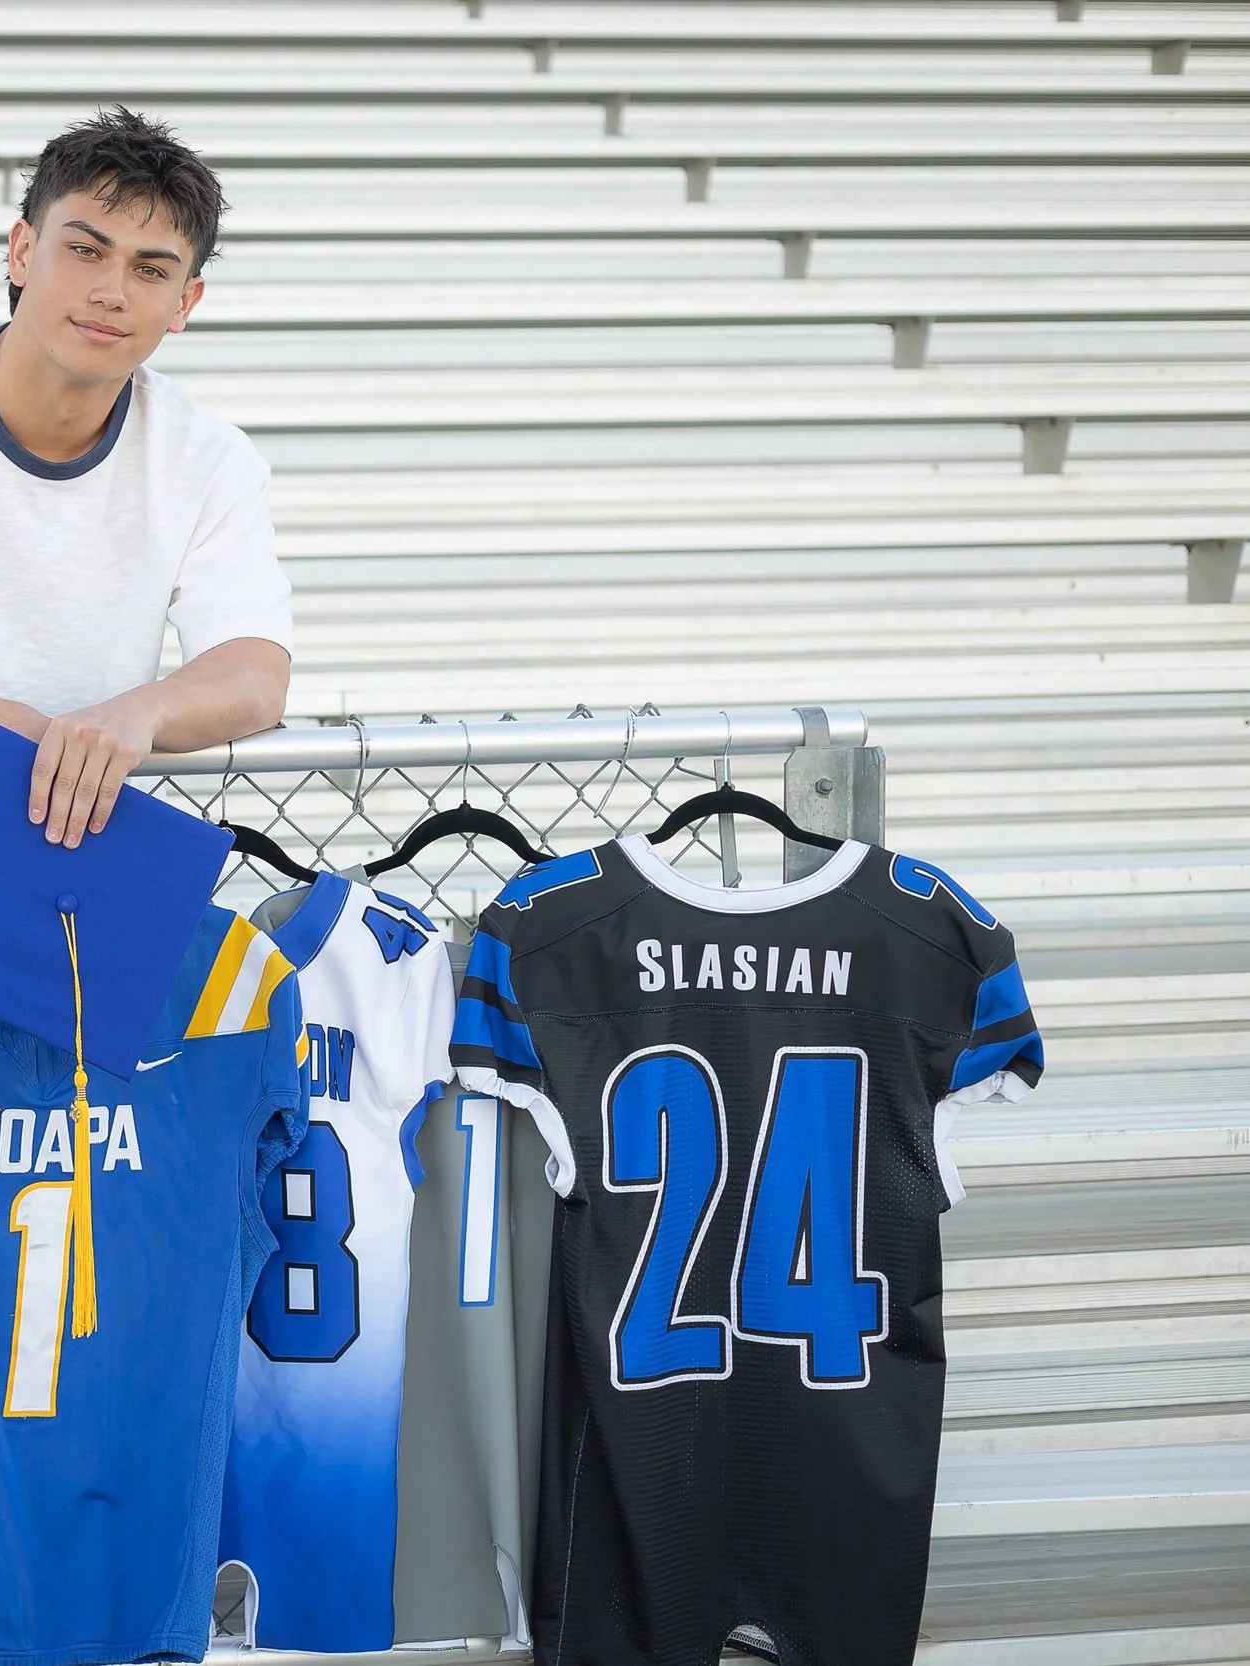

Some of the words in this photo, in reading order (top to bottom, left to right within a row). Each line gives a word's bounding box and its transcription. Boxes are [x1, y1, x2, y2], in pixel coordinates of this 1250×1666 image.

[636, 938, 853, 997] SLASIAN
[3, 1180, 77, 1418] 1
[246, 1120, 361, 1364] 8
[456, 1094, 503, 1307] 1
[601, 1043, 889, 1392] 24
